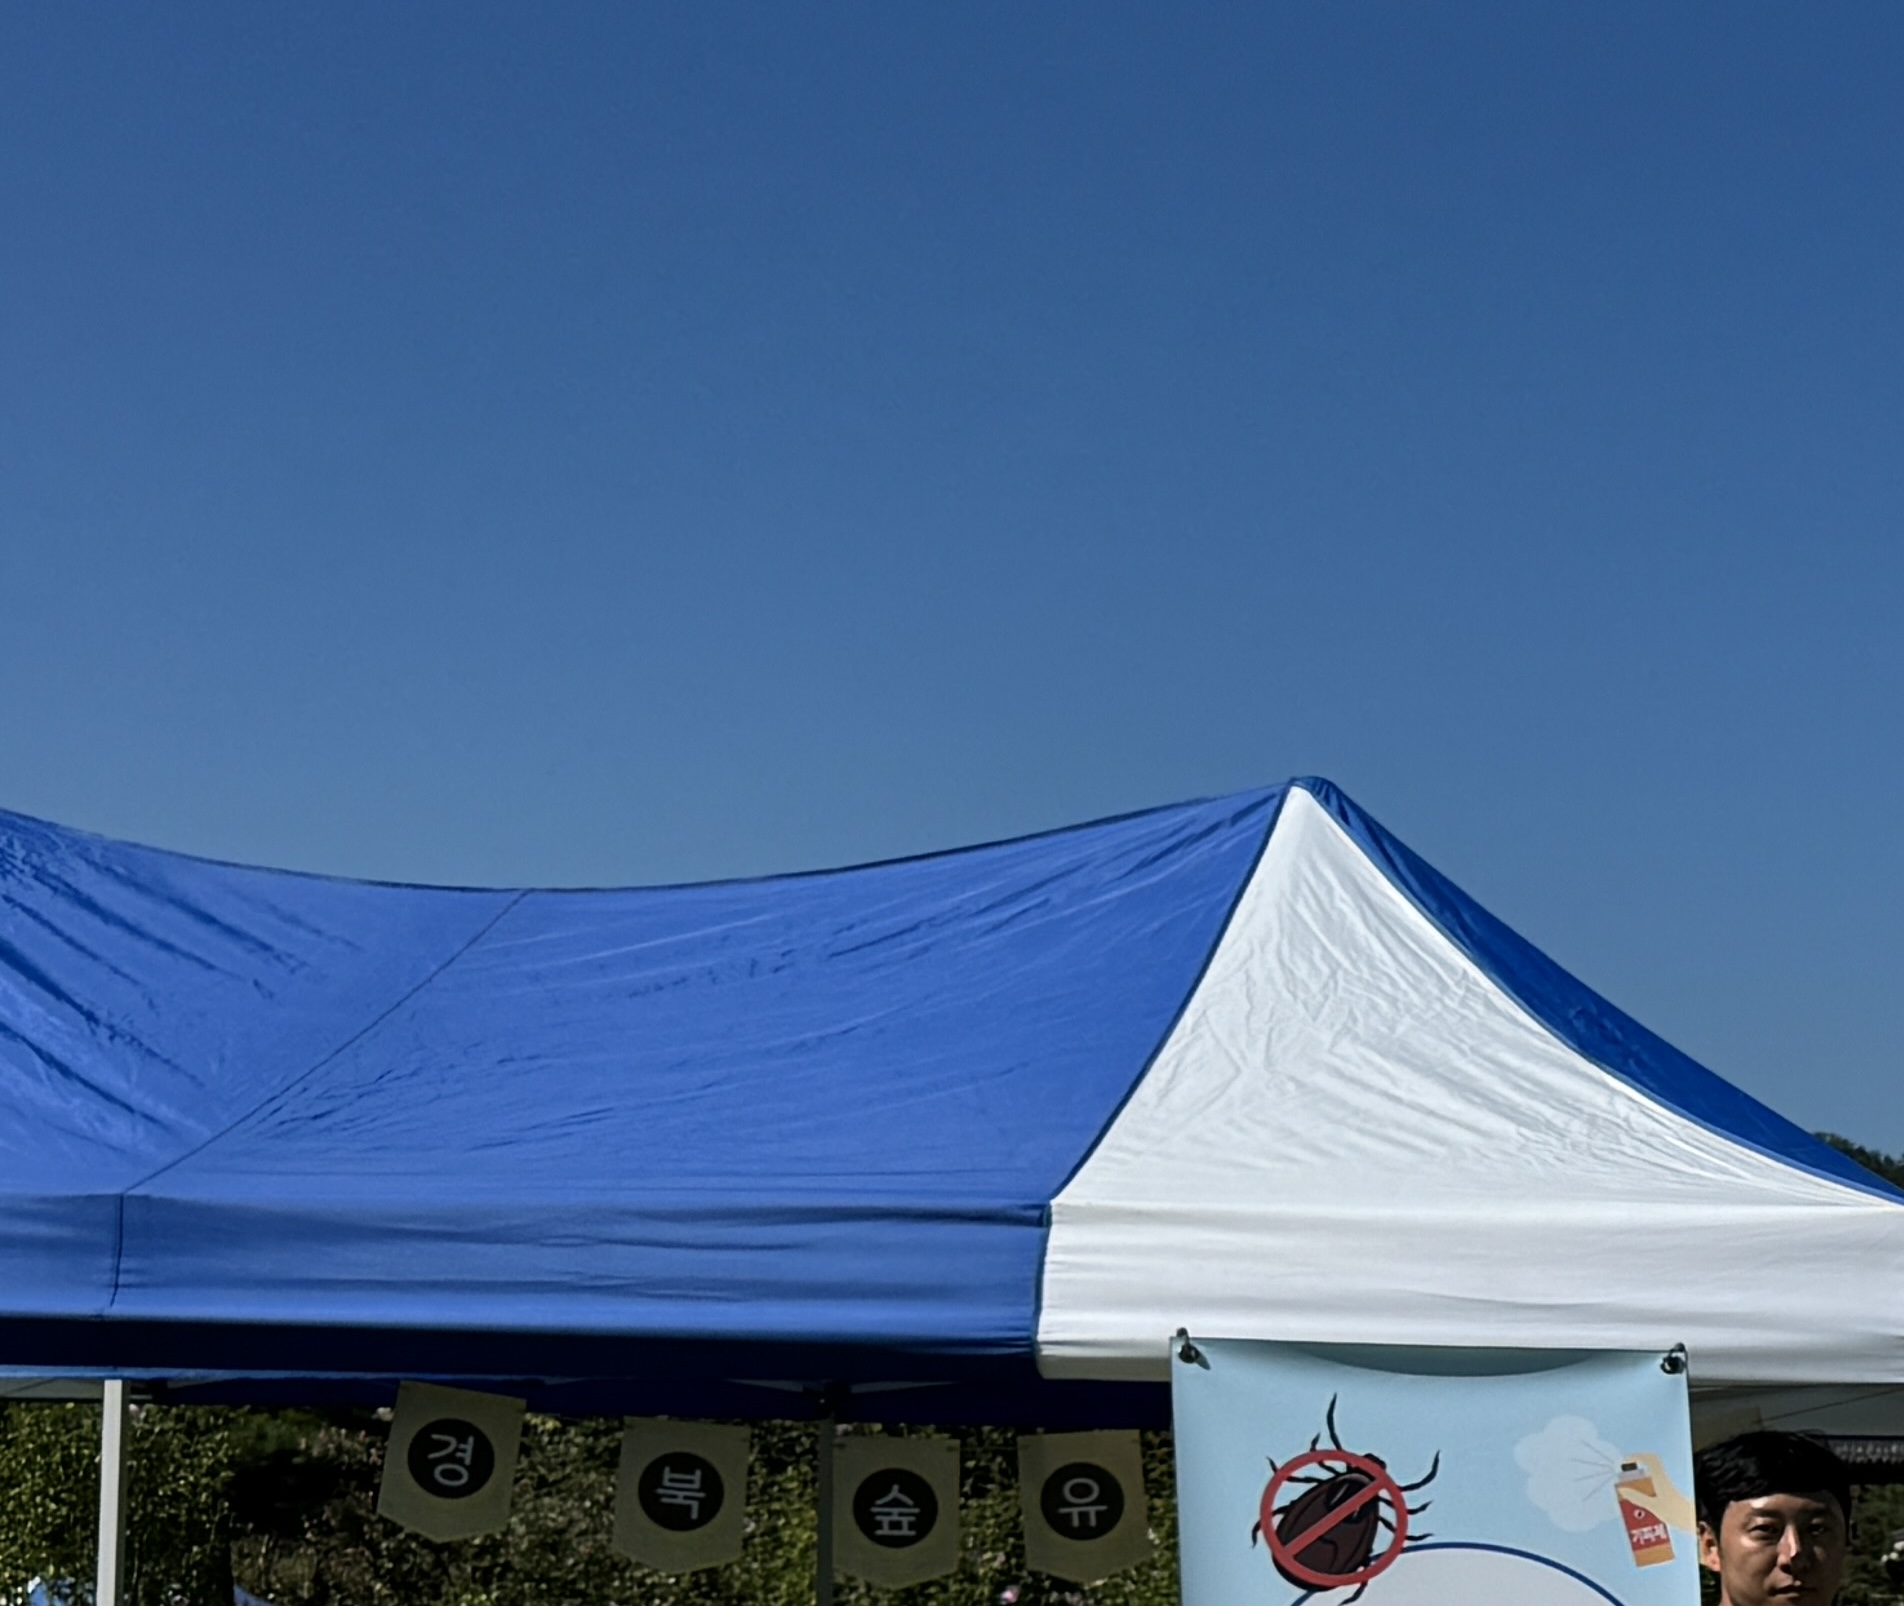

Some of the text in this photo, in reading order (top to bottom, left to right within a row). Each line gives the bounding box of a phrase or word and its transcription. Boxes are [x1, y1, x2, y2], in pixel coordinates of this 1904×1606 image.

[426, 1432, 1108, 1539] 경 북 숲 유
